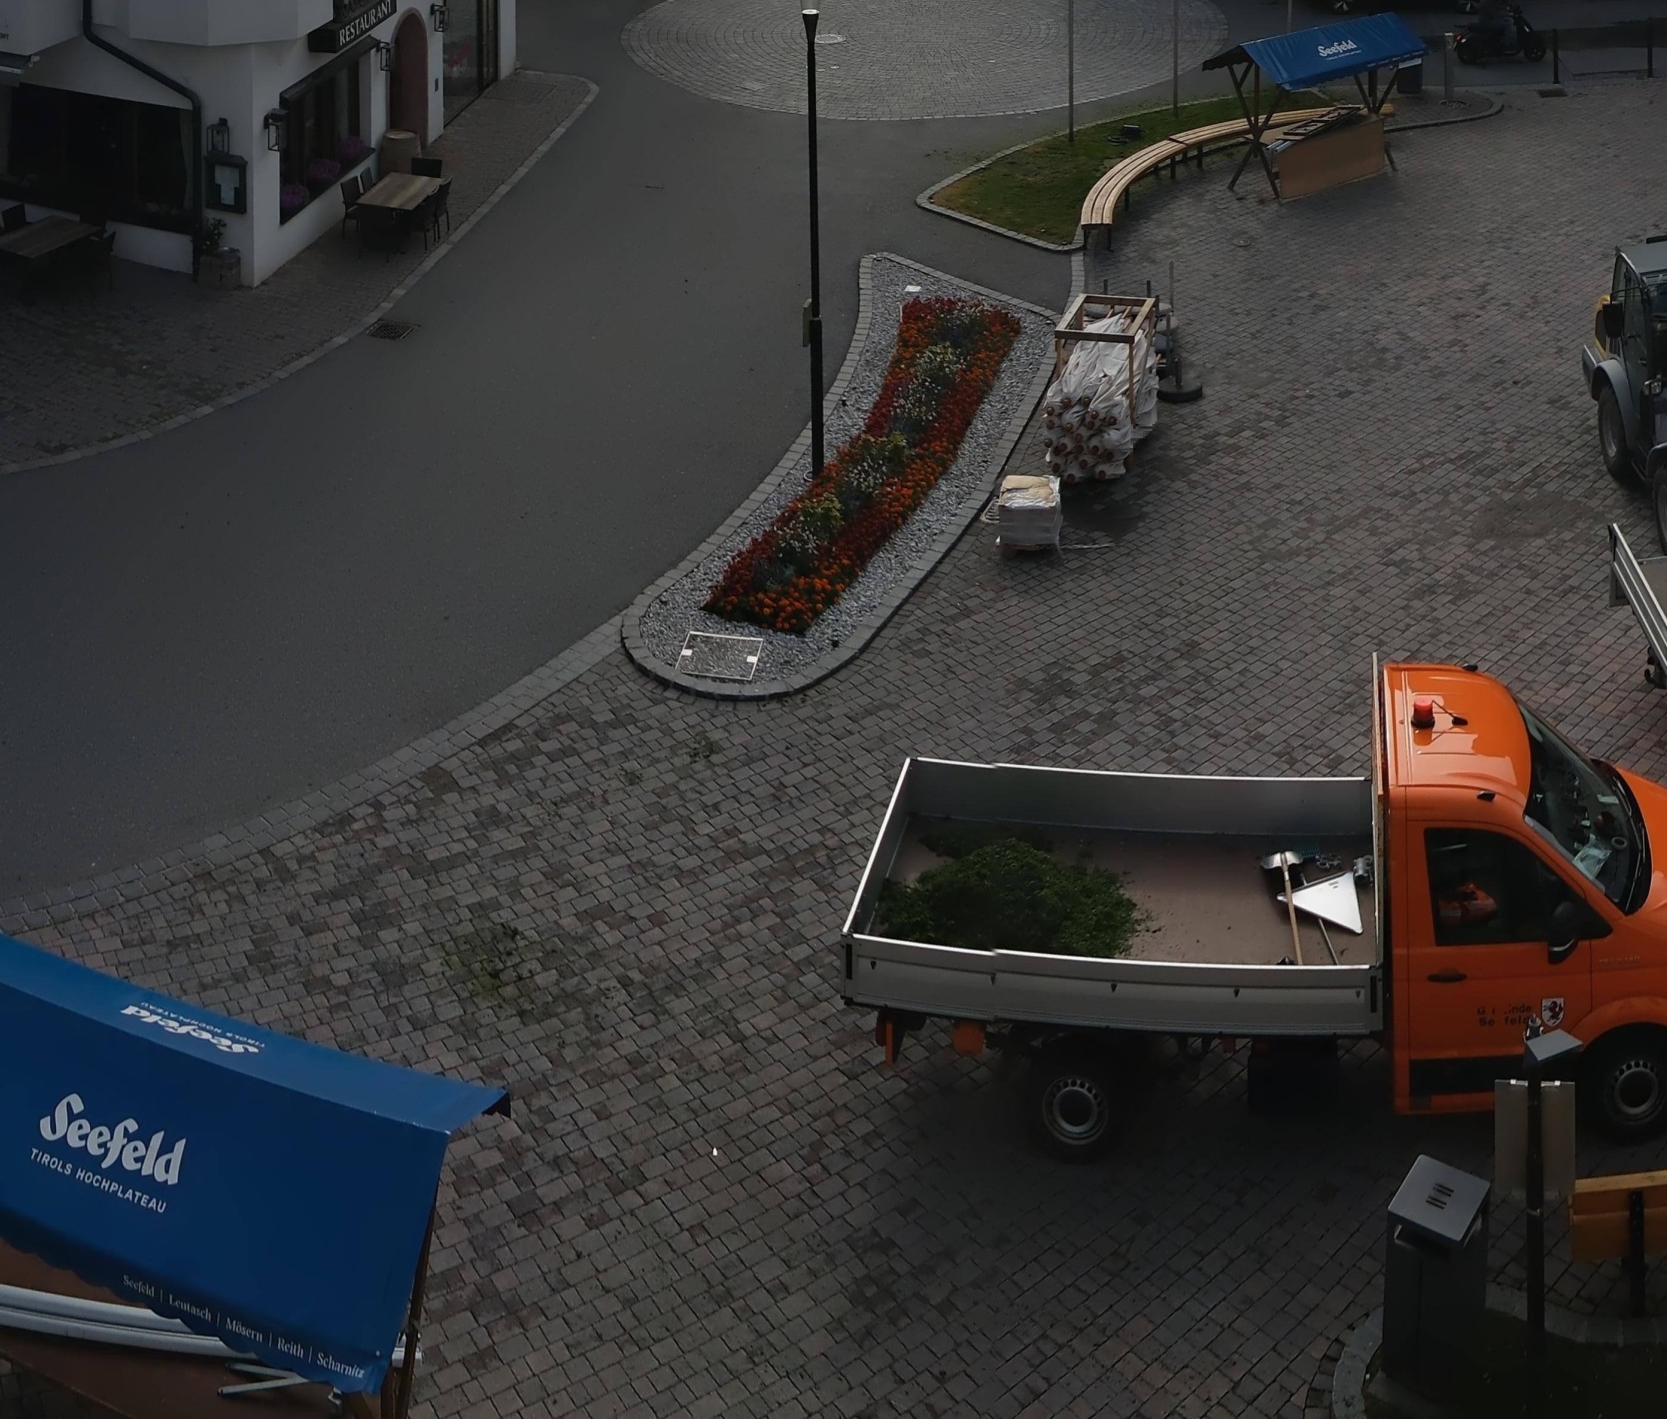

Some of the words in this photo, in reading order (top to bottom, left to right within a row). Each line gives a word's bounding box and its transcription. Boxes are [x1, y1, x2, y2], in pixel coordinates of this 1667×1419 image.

[1317, 39, 1358, 57] Seefeld
[120, 1005, 259, 1053] Seefeld
[40, 1093, 187, 1186] Seefeld
[30, 1148, 73, 1175] TIROLS
[76, 1167, 167, 1214] HOCHPLATEAU
[123, 1274, 156, 1298] Seefeld
[169, 1293, 212, 1323] Leutasch
[225, 1316, 263, 1344] Mösern
[277, 1337, 304, 1359] Reith
[316, 1352, 366, 1379] Scharnitz
